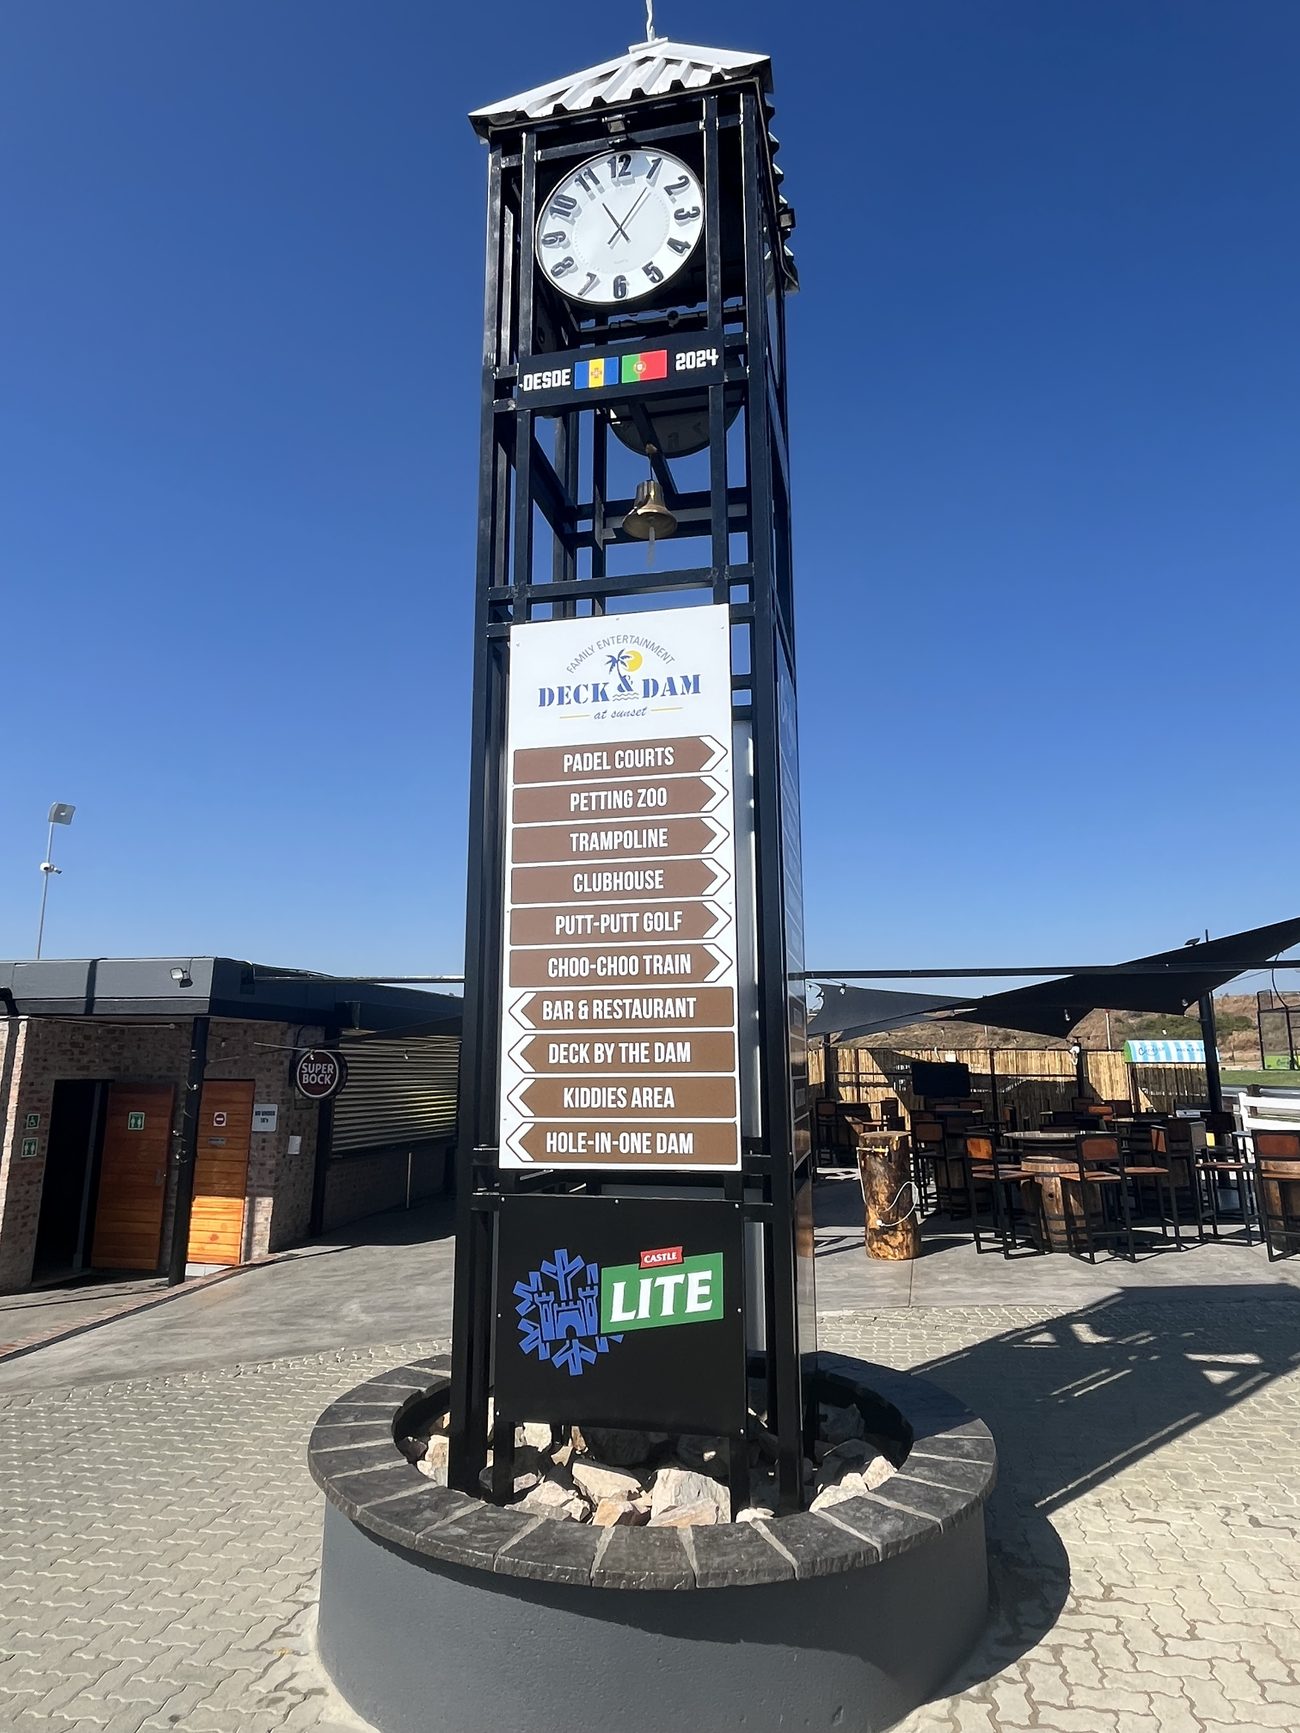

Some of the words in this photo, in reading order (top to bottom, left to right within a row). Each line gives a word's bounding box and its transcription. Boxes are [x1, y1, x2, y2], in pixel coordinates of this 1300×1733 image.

[607, 154, 632, 178] 12
[646, 157, 663, 179] 1
[574, 166, 599, 193] 11
[664, 175, 690, 197] 2
[549, 194, 577, 220] 10
[674, 206, 701, 221] 3
[541, 231, 567, 248] 9
[667, 237, 691, 254] 4
[550, 256, 575, 277] 8
[642, 261, 664, 284] 5
[577, 272, 597, 296] 7
[613, 275, 628, 299] 6
[523, 368, 571, 392] DESDE
[675, 348, 719, 372] 2024
[566, 645, 595, 674] FAMILY
[596, 634, 676, 665] ENTERTAINMENT
[538, 681, 610, 708] DECK
[616, 674, 634, 693] &
[641, 673, 701, 699] DAM
[593, 709, 608, 721] at
[610, 706, 648, 719] sunset
[563, 751, 611, 773] PADEL
[614, 746, 675, 769] COURTS
[569, 790, 633, 812] PETTING
[636, 787, 668, 808] ZOO
[569, 828, 669, 852] TRAMPOLINE
[572, 869, 664, 893] CLUBHOUSE
[554, 912, 640, 935] PUTT-PUTT
[643, 911, 683, 932] GOLF
[547, 955, 640, 978] CHOO-CHOO
[642, 954, 692, 975] TRAIN
[542, 1000, 574, 1021] BAR
[577, 1000, 590, 1020] &
[592, 997, 697, 1019] RESTAURANT
[548, 1043, 590, 1064] DECK
[594, 1043, 614, 1063] BY
[618, 1042, 650, 1063] THE
[653, 1042, 691, 1063] DAM
[301, 1062, 334, 1074] SUPER
[302, 1073, 332, 1085] BOCK
[563, 1087, 628, 1108] KIDDIES
[631, 1087, 675, 1108] AREA
[546, 1132, 652, 1153] HOLE-IN-ONE
[656, 1132, 694, 1154] DAM
[644, 1251, 678, 1264] CASTLE
[610, 1270, 713, 1322] LITE
